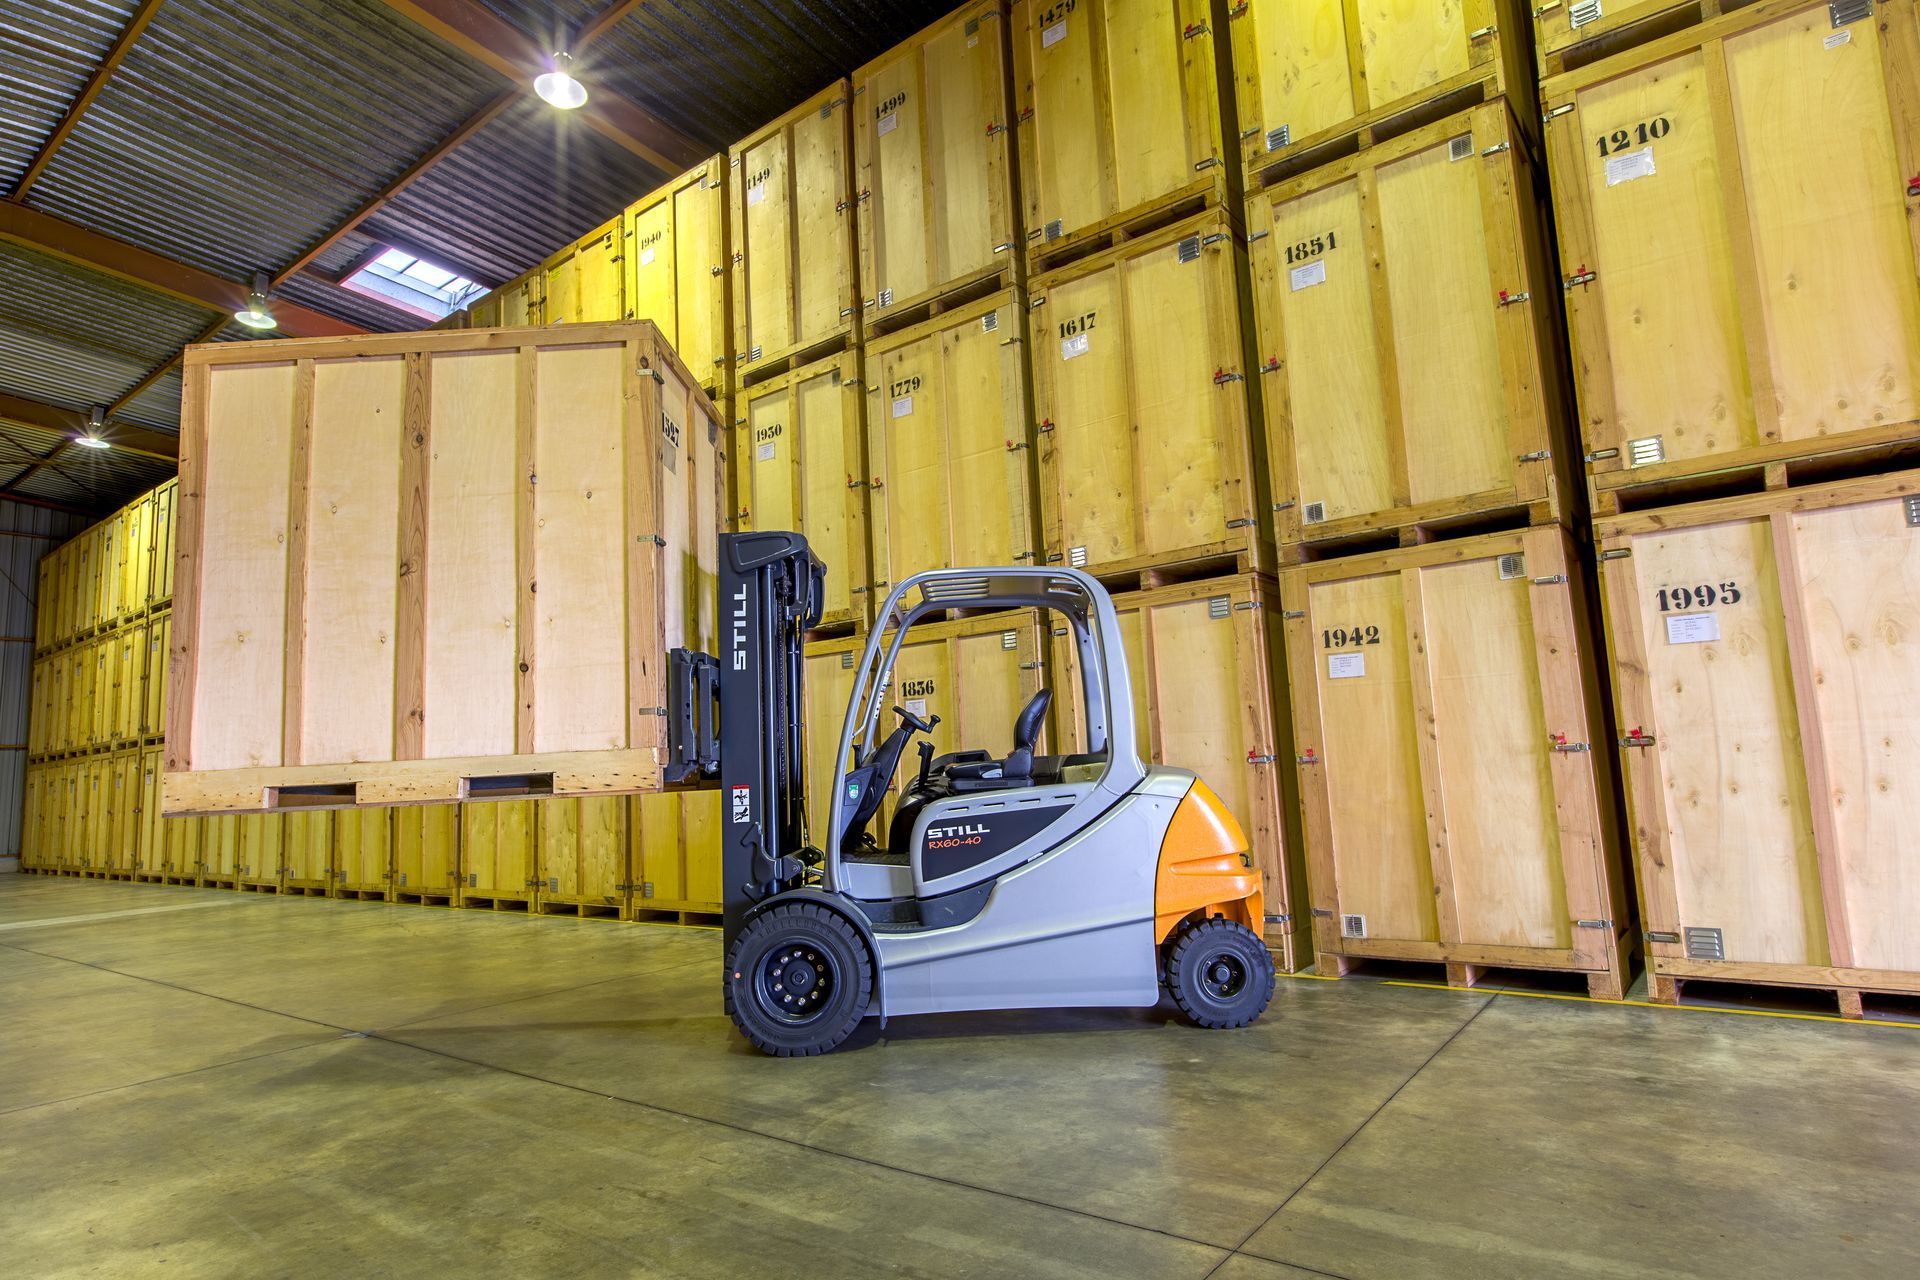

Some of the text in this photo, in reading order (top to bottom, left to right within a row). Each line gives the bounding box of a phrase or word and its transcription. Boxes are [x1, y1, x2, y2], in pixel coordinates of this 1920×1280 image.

[1039, 0, 1075, 28] 1479
[876, 92, 906, 119] 1499
[1595, 118, 1670, 158] 1210
[747, 167, 771, 191] 1149
[641, 231, 662, 250] 1940
[1284, 231, 1337, 264] 1851
[1058, 312, 1096, 339] 1617
[890, 376, 921, 398] 1779
[756, 423, 782, 443] 1930
[1655, 582, 1741, 612] 1995
[734, 583, 747, 671] STILL
[1321, 625, 1380, 649] 1942
[901, 679, 935, 697] 1836
[927, 824, 990, 839] STILL
[928, 836, 982, 849] RX60-40
